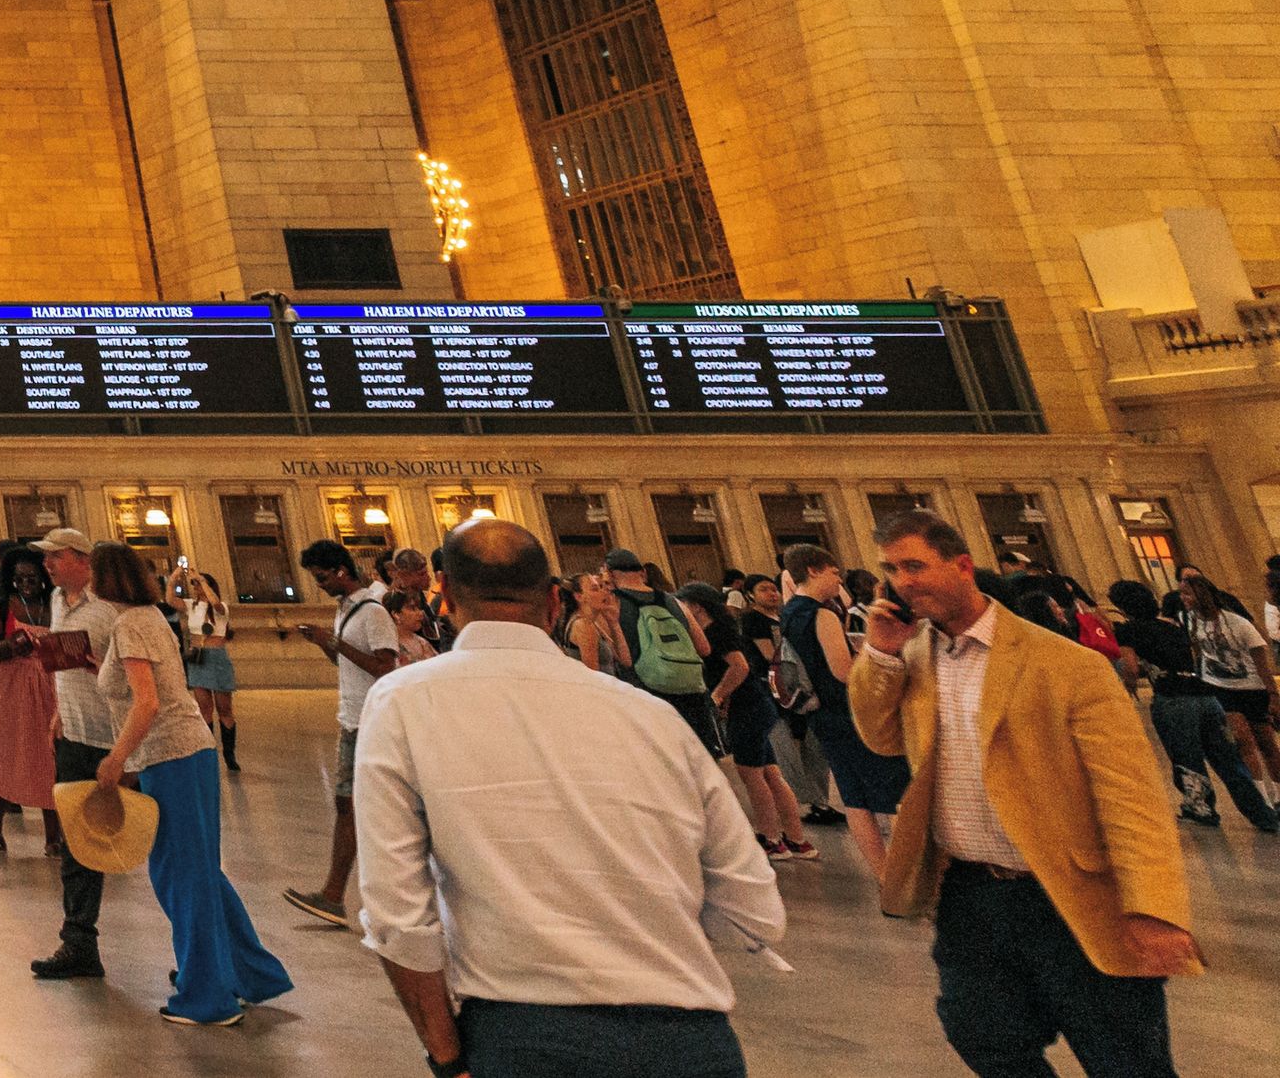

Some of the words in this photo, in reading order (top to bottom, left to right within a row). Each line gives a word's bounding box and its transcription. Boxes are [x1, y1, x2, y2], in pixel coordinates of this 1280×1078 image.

[32, 307, 83, 318] HARLEM
[84, 307, 113, 317] LINE
[114, 307, 193, 317] DEPARTURES
[364, 307, 415, 317] HARLEM
[416, 307, 446, 317] LINE
[447, 306, 526, 317] DEPARTURES
[695, 306, 749, 316] HUDSON
[749, 306, 780, 316] LINE
[780, 305, 859, 316] DEPARTURES
[95, 326, 137, 334] REMARKS
[20, 351, 65, 359] SOUTHEAST
[282, 460, 320, 474] MTA
[327, 460, 464, 475] METRO-NORTH
[467, 460, 543, 475] TICKETS
